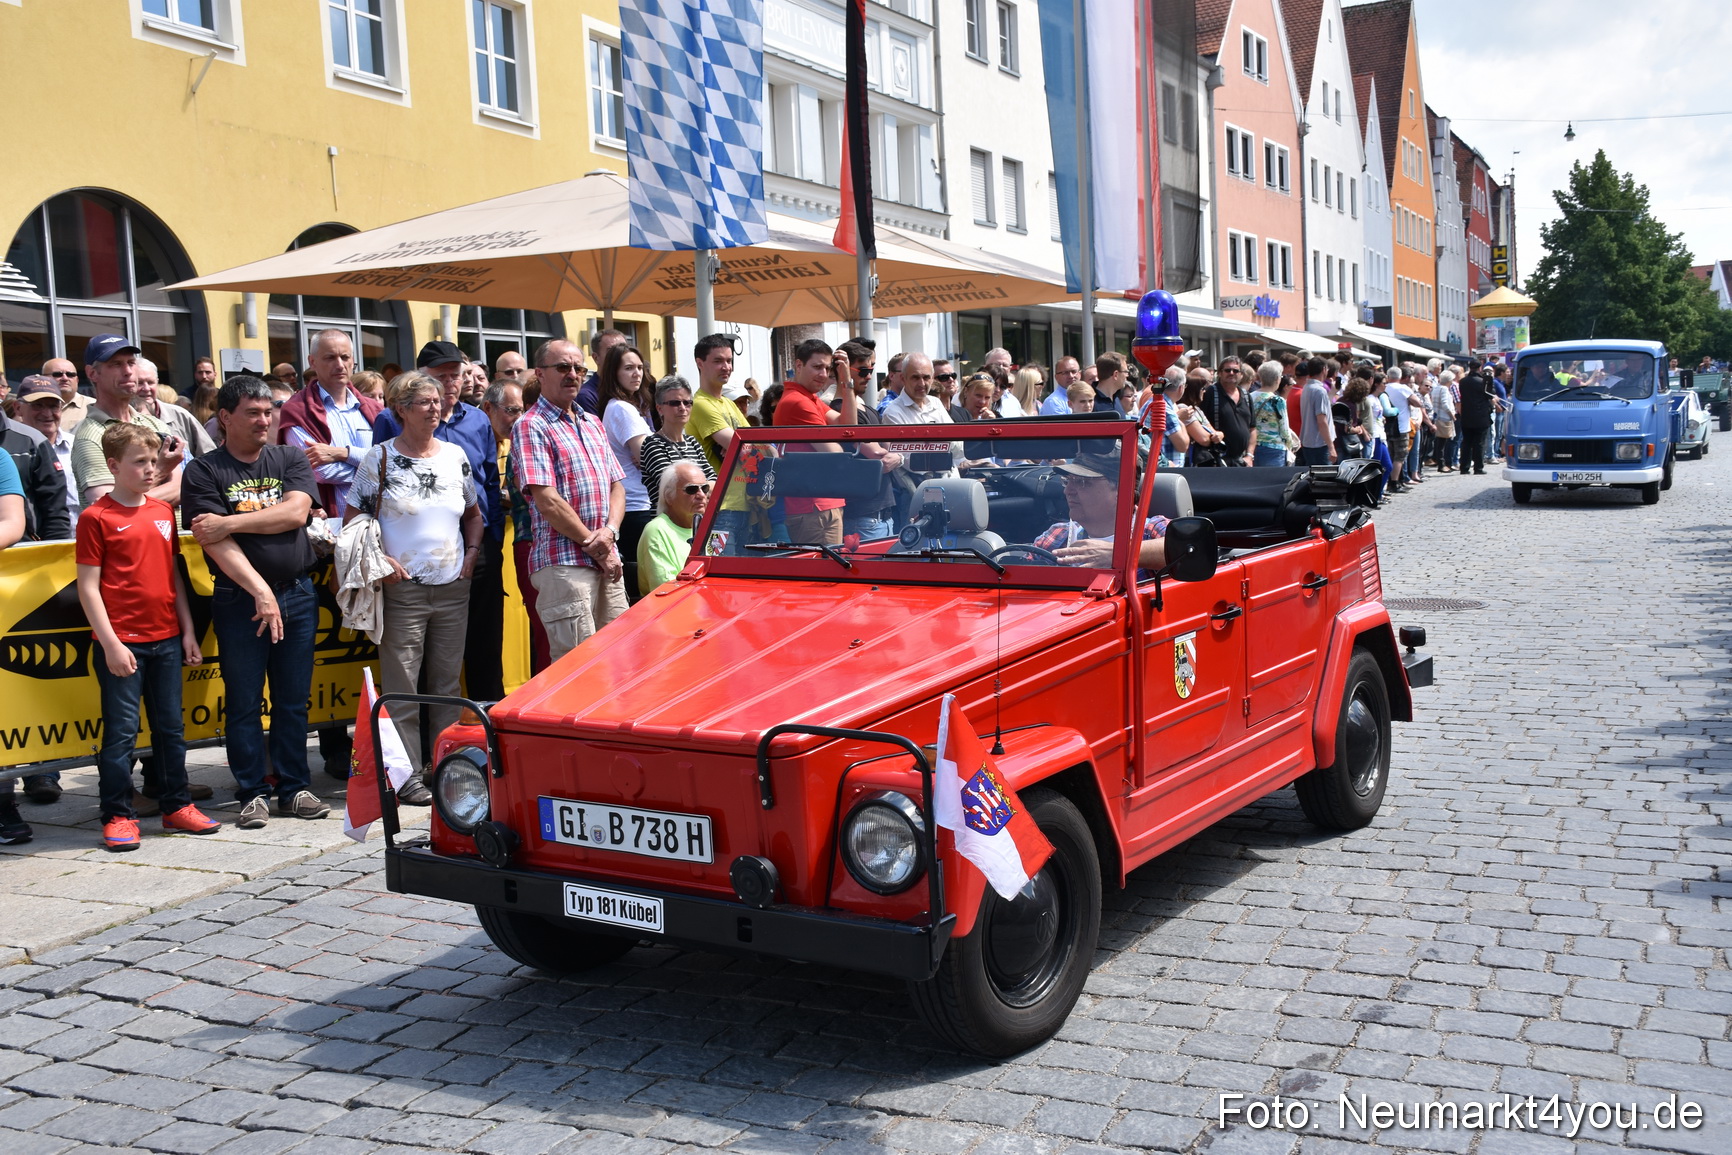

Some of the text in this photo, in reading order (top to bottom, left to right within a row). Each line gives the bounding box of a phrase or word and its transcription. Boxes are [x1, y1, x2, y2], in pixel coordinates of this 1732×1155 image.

[765, 1, 822, 49] BRILLEN
[334, 237, 542, 265] Lammsbräu
[387, 229, 537, 250] Neumarkter
[890, 443, 949, 452] FEUERWEHR
[545, 823, 552, 833] D
[559, 805, 705, 857] GI B 738 H
[570, 890, 658, 924] Typ 181 Kübel
